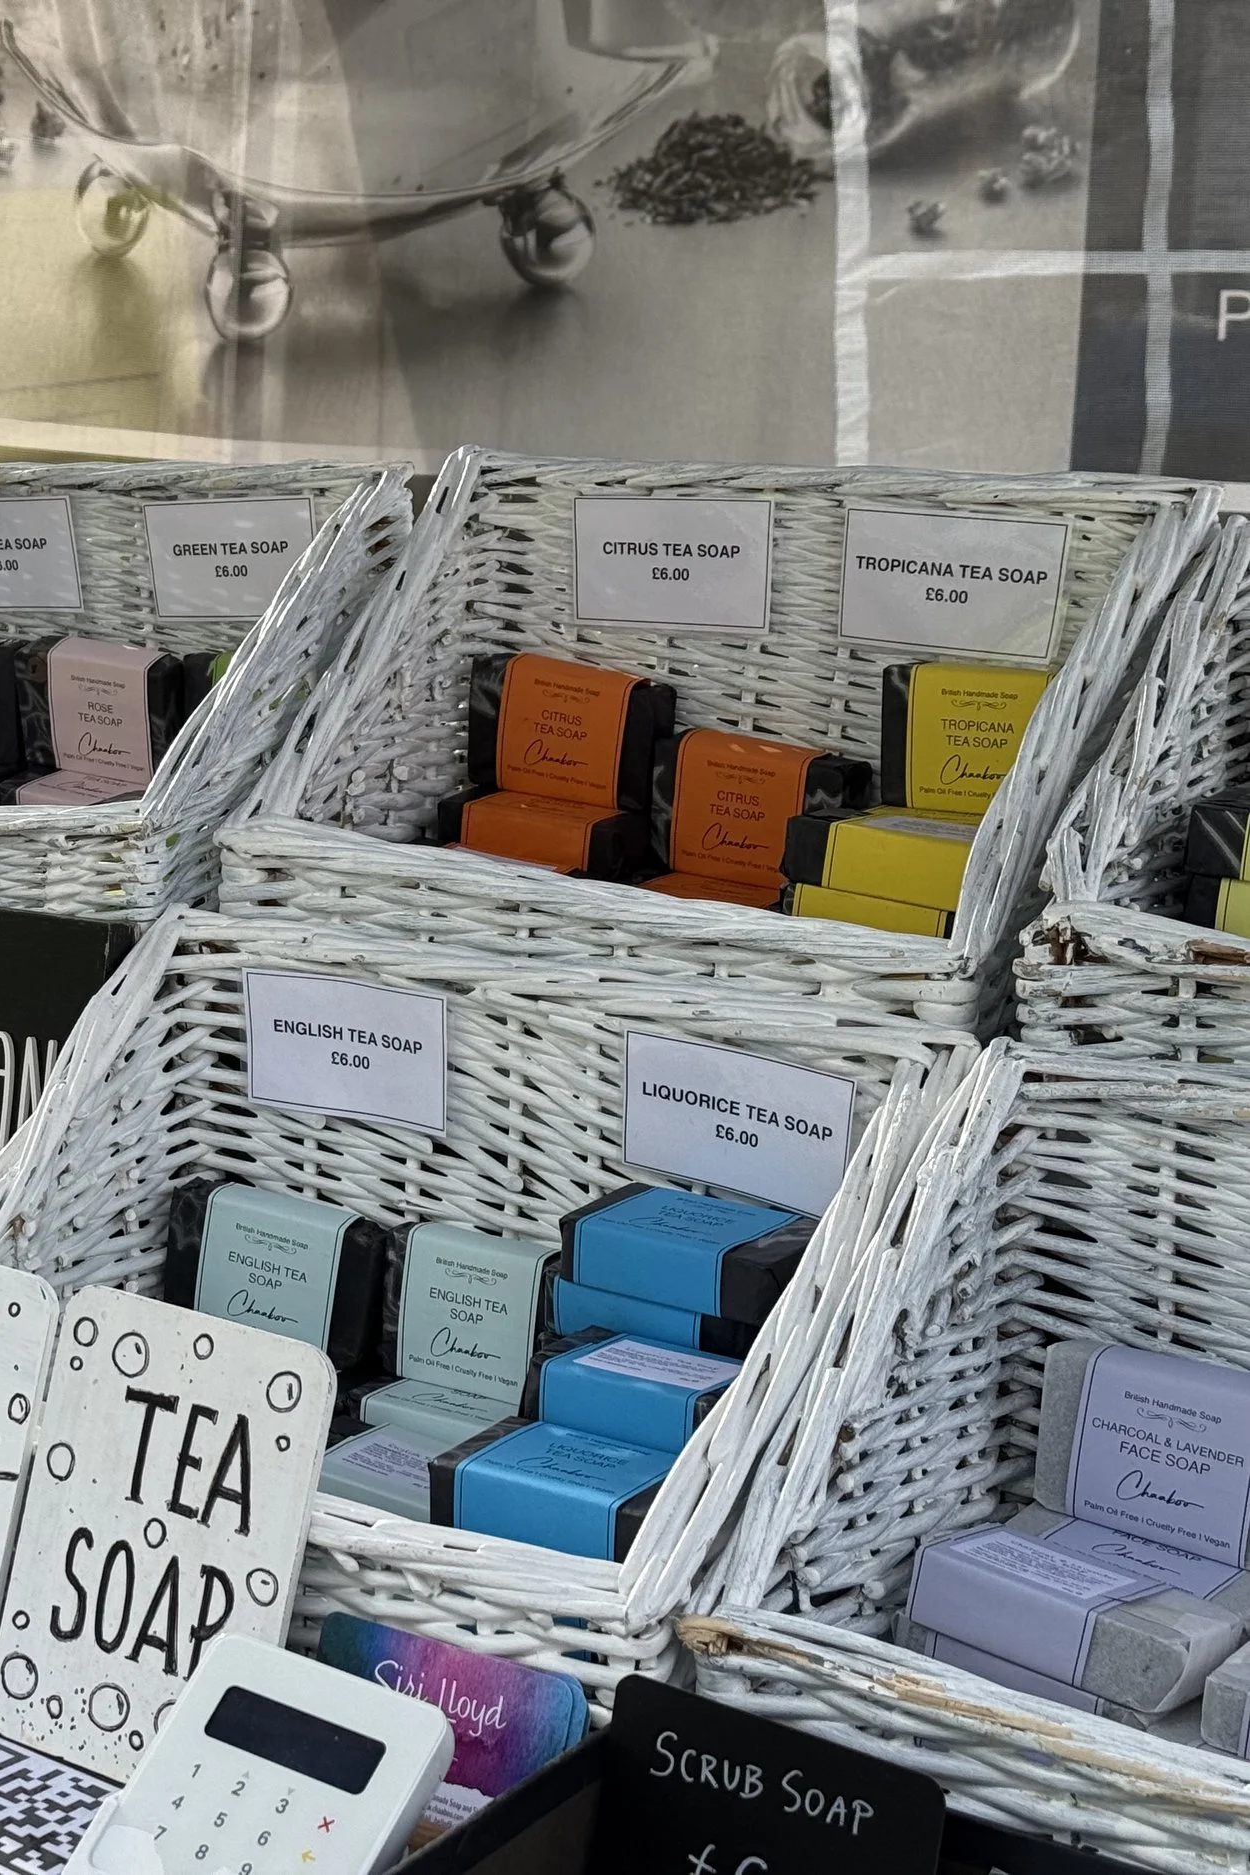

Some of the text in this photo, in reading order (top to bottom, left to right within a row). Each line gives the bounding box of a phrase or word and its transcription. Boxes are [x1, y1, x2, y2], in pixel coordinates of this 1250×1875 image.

[15, 538, 47, 550] SOAP
[173, 541, 288, 556] GREEN TEA SOAP
[603, 541, 740, 559] CITRUS TEA SOAP
[215, 565, 248, 577] £6.00
[652, 567, 689, 581] £6.00
[856, 555, 1048, 585] TROPICANA TEA SOAP
[925, 587, 968, 604] £6.00
[941, 688, 1018, 700] British Handmade Soap
[88, 702, 113, 713] ROSE
[541, 709, 582, 726] CITRUS
[78, 712, 123, 727] TEA SOAP
[534, 722, 587, 740] TEA SOAP
[941, 719, 1014, 733] TROPICANA
[946, 735, 1008, 749] TEA SOAP
[717, 790, 759, 806] CITRUS
[919, 786, 935, 794] Palm
[937, 786, 945, 795] Oil
[948, 788, 962, 796] Free
[968, 790, 991, 800] Cruelty
[710, 804, 765, 821] TEA SOAP
[274, 1019, 422, 1055] ENGLISH TEA SOAP
[331, 1051, 370, 1070] £6.00
[642, 1081, 833, 1141] LIQUORICE TEA SOAP
[715, 1124, 759, 1148] £6.00
[236, 1222, 308, 1250] British Handmade Soap
[228, 1251, 307, 1283] ENGLISH TEA
[436, 1256, 508, 1280] British Handmade Soap
[248, 1272, 282, 1290] SOAP
[429, 1287, 508, 1315] ENGLISH TEA
[450, 1308, 483, 1325] SOAP
[408, 1354, 424, 1364] Palm
[426, 1358, 435, 1367] Oil
[436, 1360, 450, 1371] Free
[478, 1372, 493, 1382] Free
[1124, 1390, 1222, 1424] British Handmade Soap
[549, 1442, 630, 1465] LIQUORICE
[1092, 1417, 1245, 1468] CHARCOAL & LAVENDER
[125, 1386, 252, 1536] TEA
[1120, 1441, 1211, 1475] FACE SOAP
[1084, 1500, 1230, 1549] Palm Oil Free Cruelty Free Vegan
[50, 1527, 235, 1681] SOAP
[191, 1763, 289, 1814] 1 2 3
[650, 1730, 875, 1835] SCRUB SOAP
[171, 1796, 272, 1846] 4 5 6
[154, 1825, 253, 1875] 7 8 9
